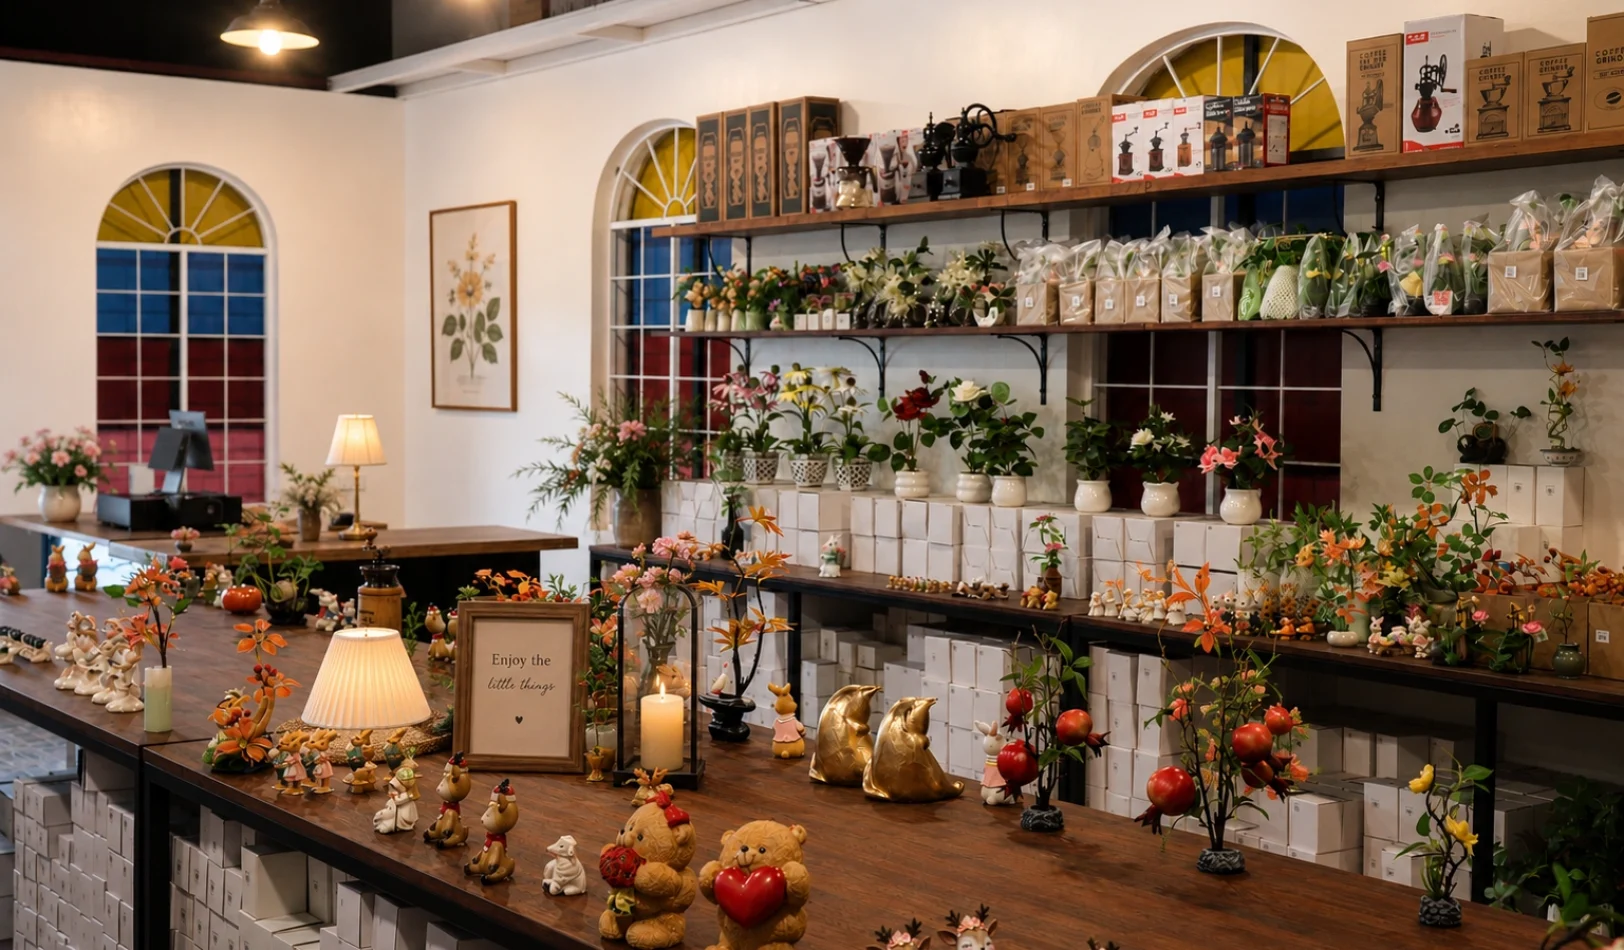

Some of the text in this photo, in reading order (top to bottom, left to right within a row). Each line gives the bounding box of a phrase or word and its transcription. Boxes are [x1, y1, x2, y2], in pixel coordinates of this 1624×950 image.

[491, 653, 551, 669] Enjoy the
[487, 676, 556, 697] little things
